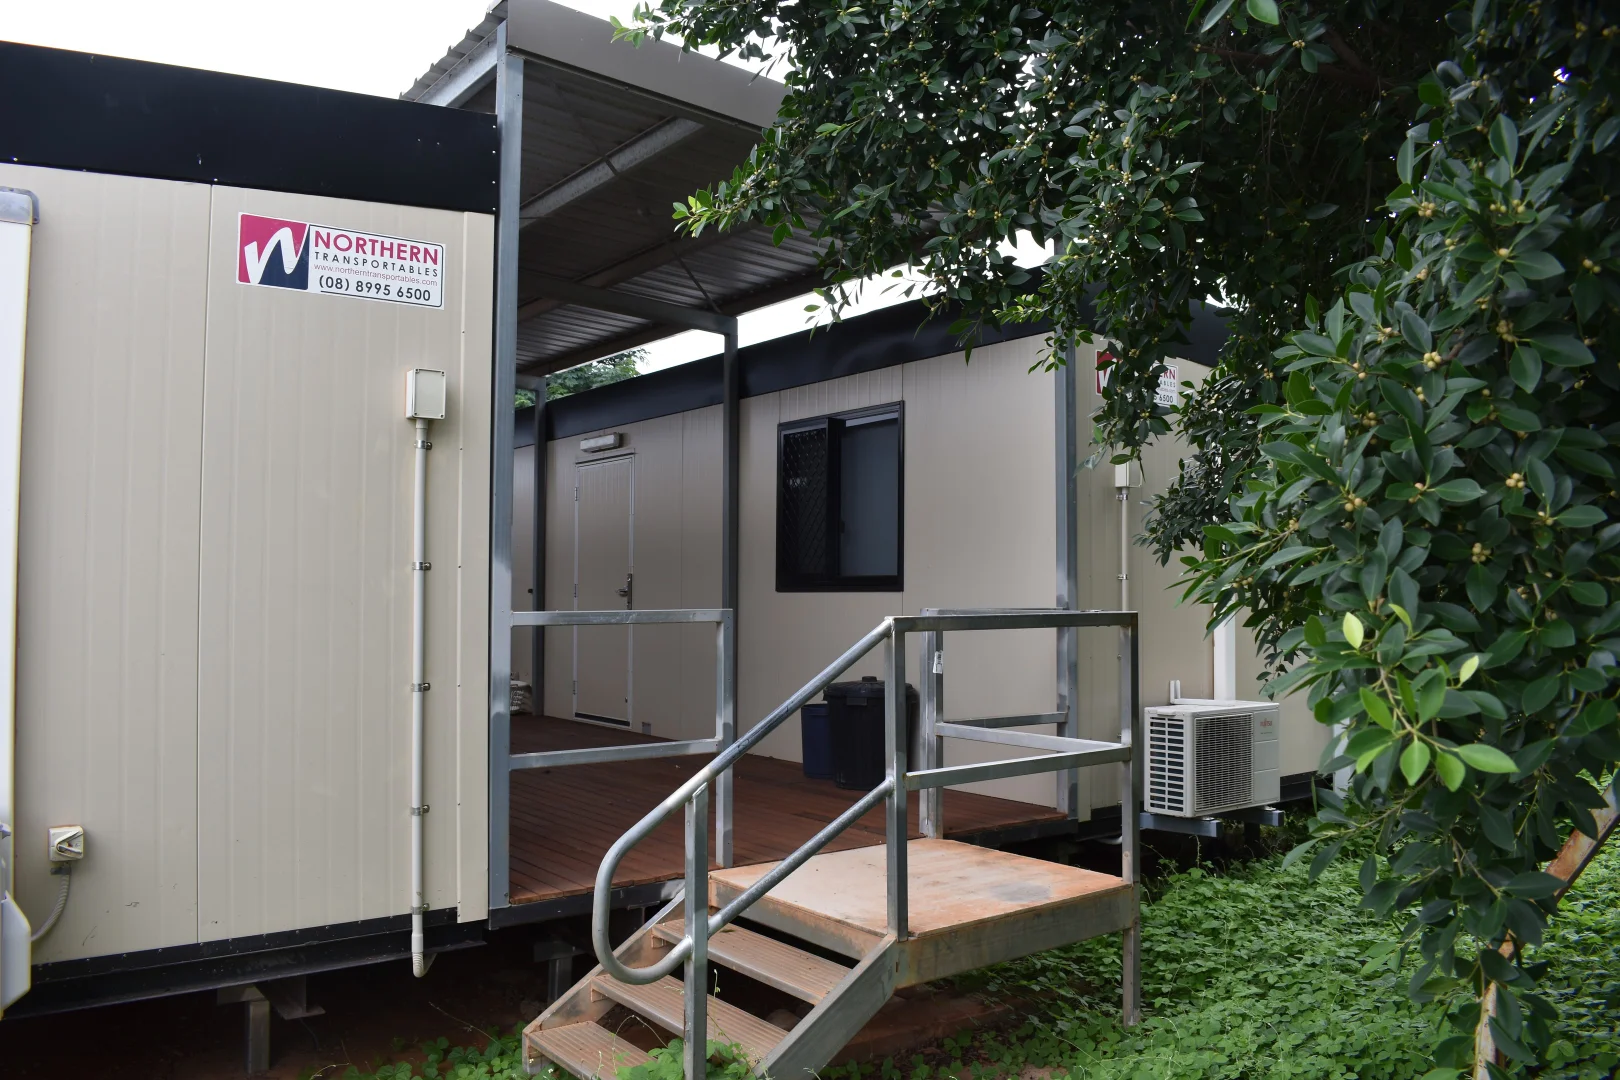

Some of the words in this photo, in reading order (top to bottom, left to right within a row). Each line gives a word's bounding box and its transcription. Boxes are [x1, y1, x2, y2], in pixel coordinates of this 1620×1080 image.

[314, 230, 438, 266] NORTHERN
[314, 251, 438, 277] TRANSPORTABLES
[314, 264, 438, 287] www.northerntransportables.com
[319, 275, 350, 291] (08)
[356, 281, 391, 296] 8995
[397, 286, 431, 302] 6500
[1159, 393, 1173, 403] 6500
